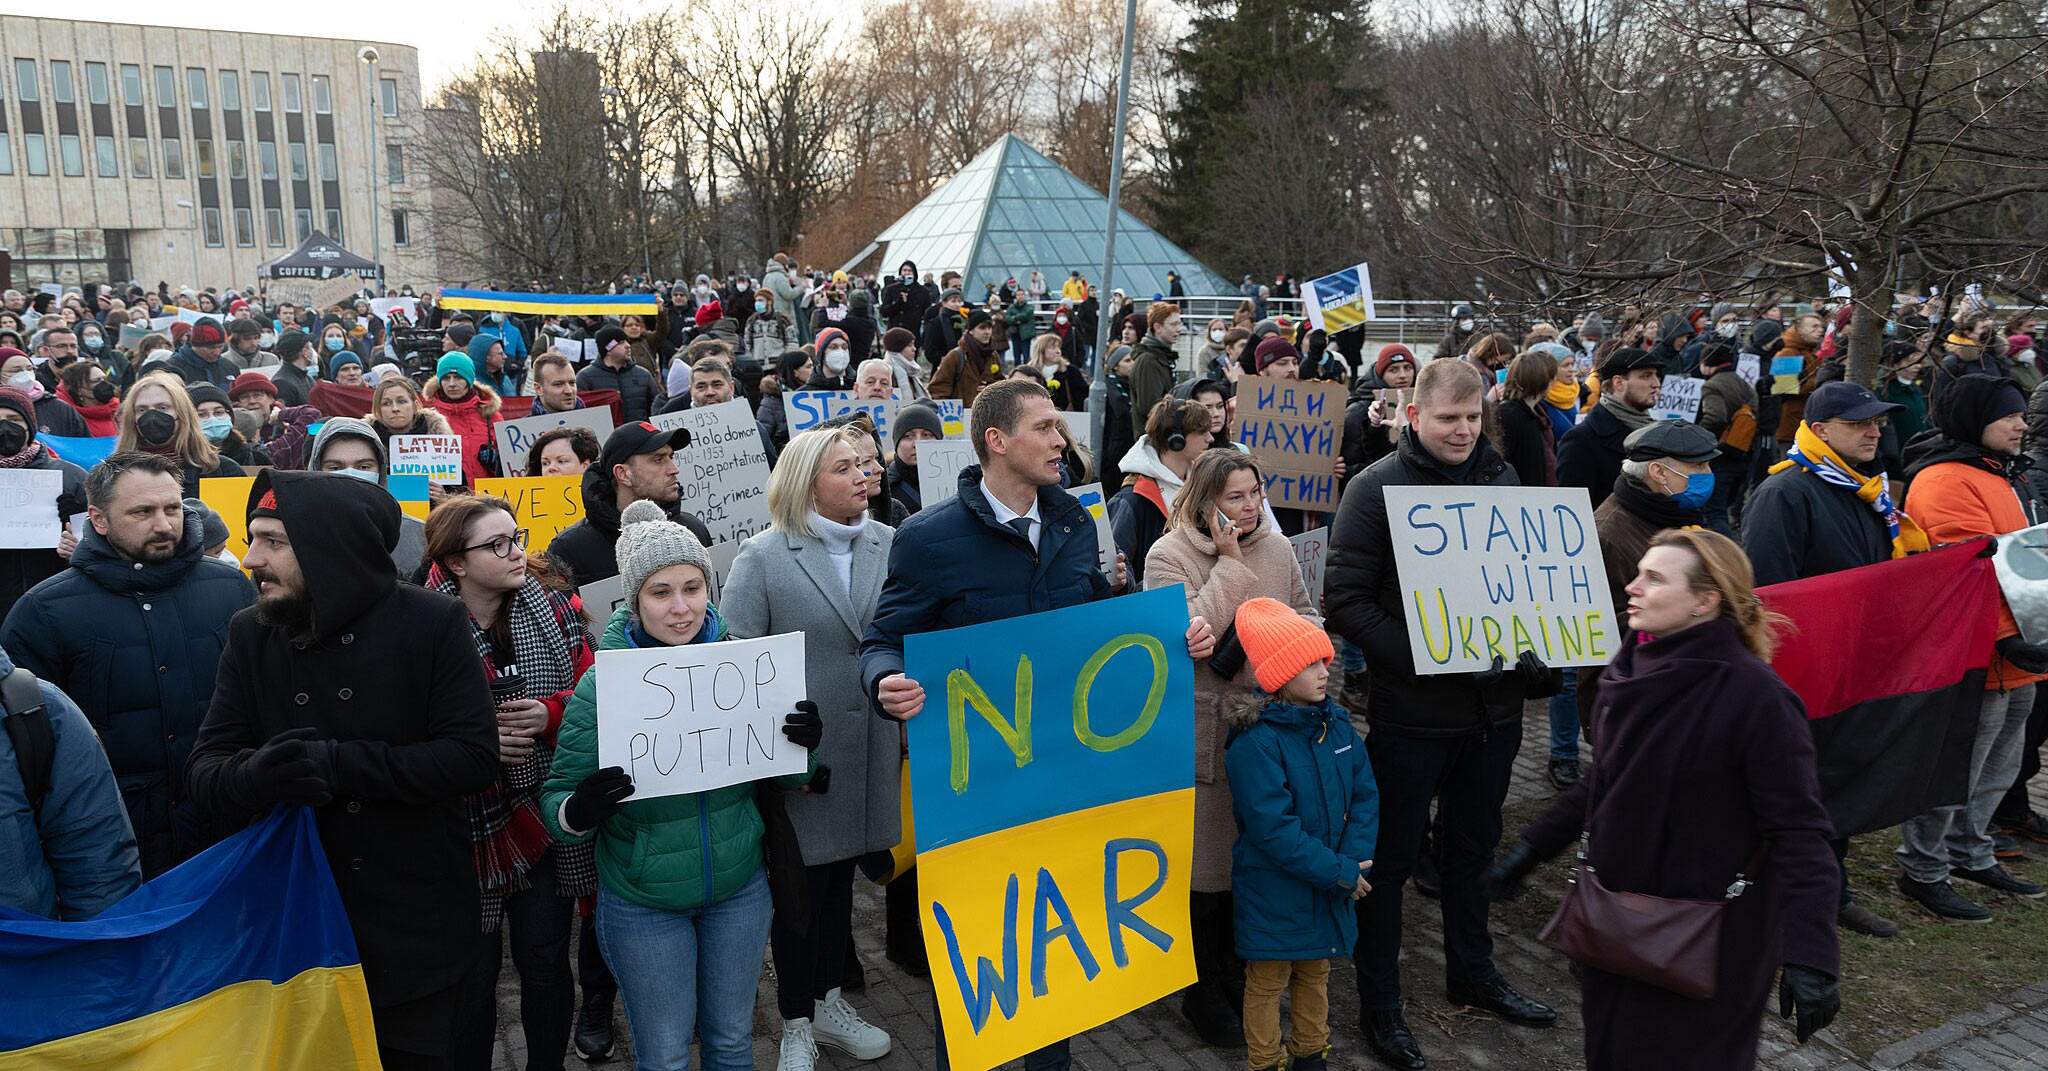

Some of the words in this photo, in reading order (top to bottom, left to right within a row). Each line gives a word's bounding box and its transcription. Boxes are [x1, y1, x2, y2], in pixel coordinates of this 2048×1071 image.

[279, 267, 316, 276] COFFEE
[1258, 384, 1325, 418] ИДИ
[398, 438, 460, 453] LATVIA
[1240, 419, 1334, 457] НАХУЙ
[693, 450, 768, 482] Deportations
[707, 485, 764, 509] Crimea
[1263, 473, 1333, 503] УТИН
[695, 507, 729, 524] 022
[1408, 502, 1585, 557] STAND
[643, 651, 776, 720] STOP
[946, 633, 1169, 795] NO
[629, 716, 775, 784] PUTIN
[933, 837, 1175, 1036] WAR
